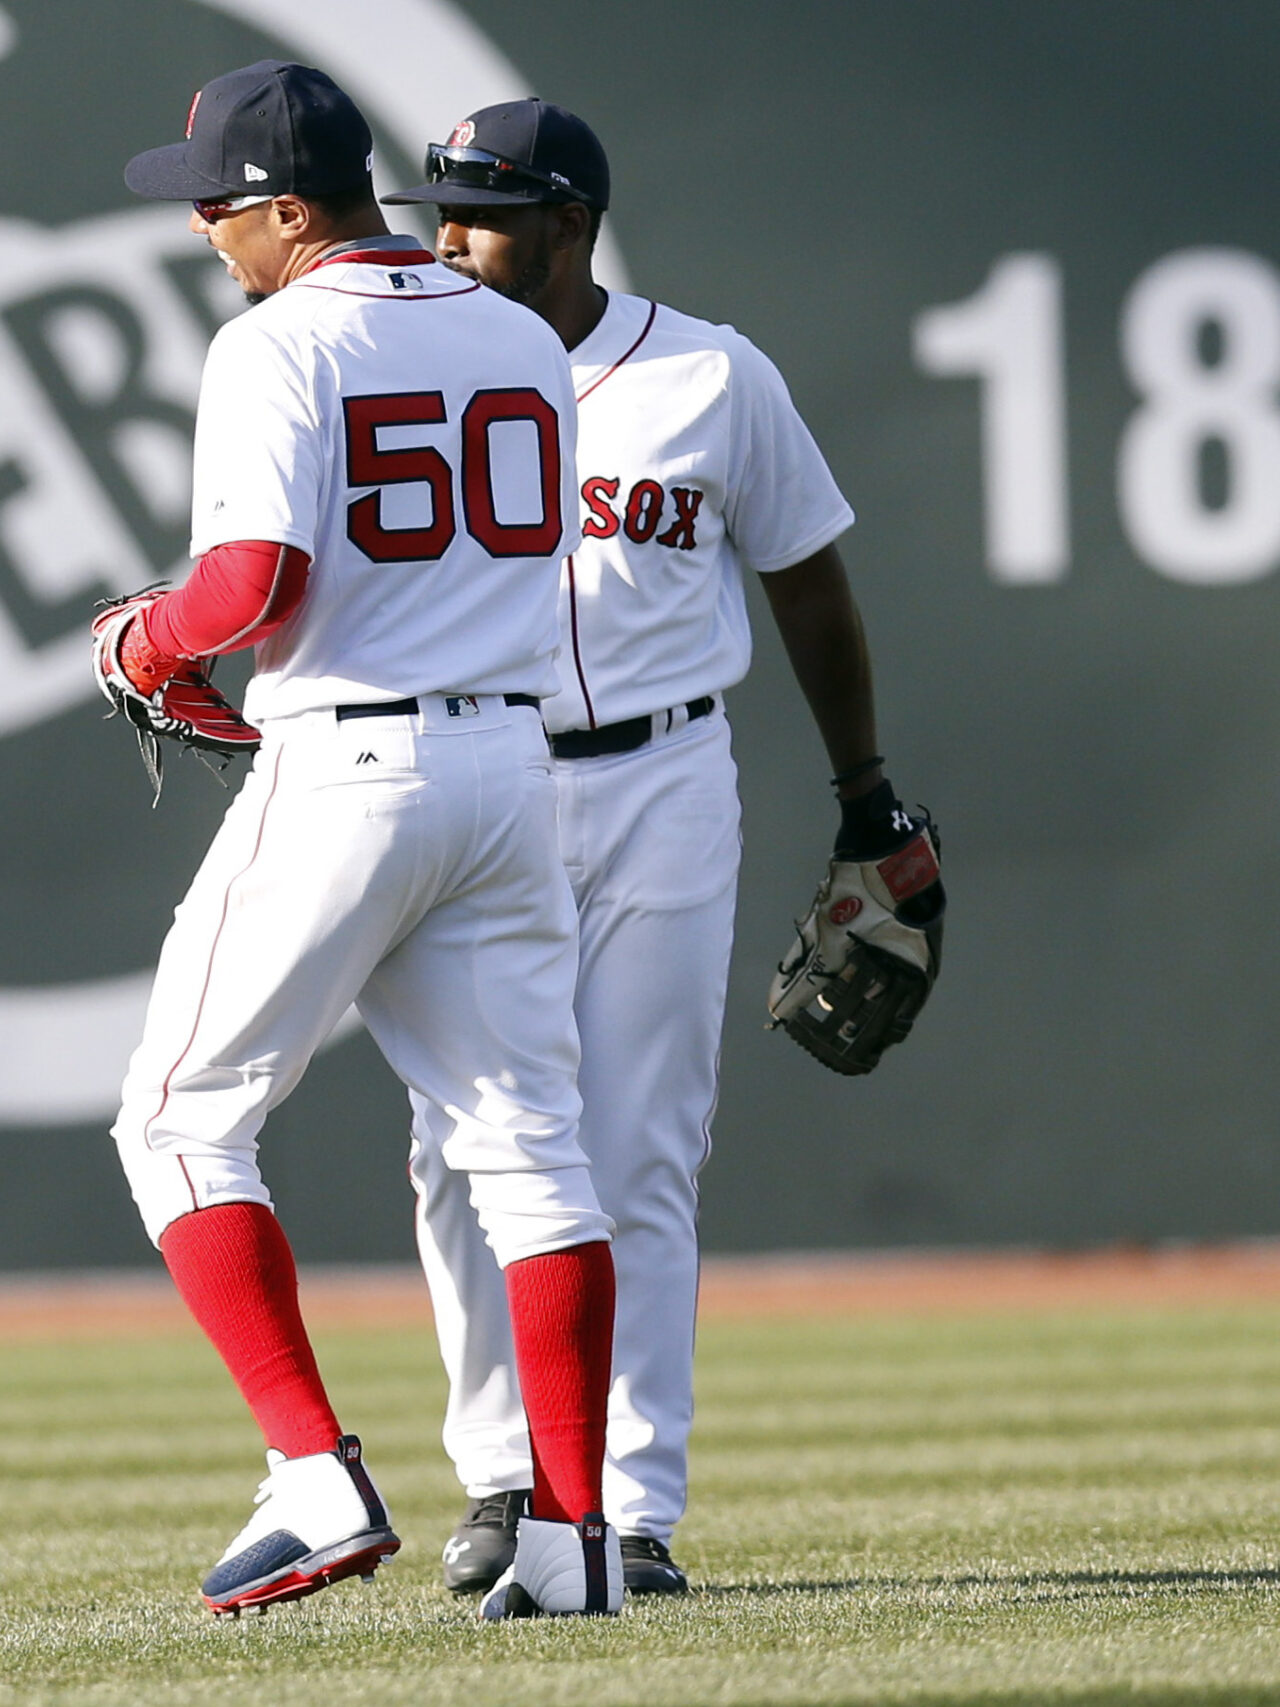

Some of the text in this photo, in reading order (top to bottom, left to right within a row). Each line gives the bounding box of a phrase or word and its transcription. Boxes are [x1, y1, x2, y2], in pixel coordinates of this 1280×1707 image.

[914, 247, 1280, 584] 18
[342, 387, 563, 563] 50
[581, 476, 703, 550] SOX
[347, 1446, 360, 1459] 50
[586, 1525, 602, 1537] 50
